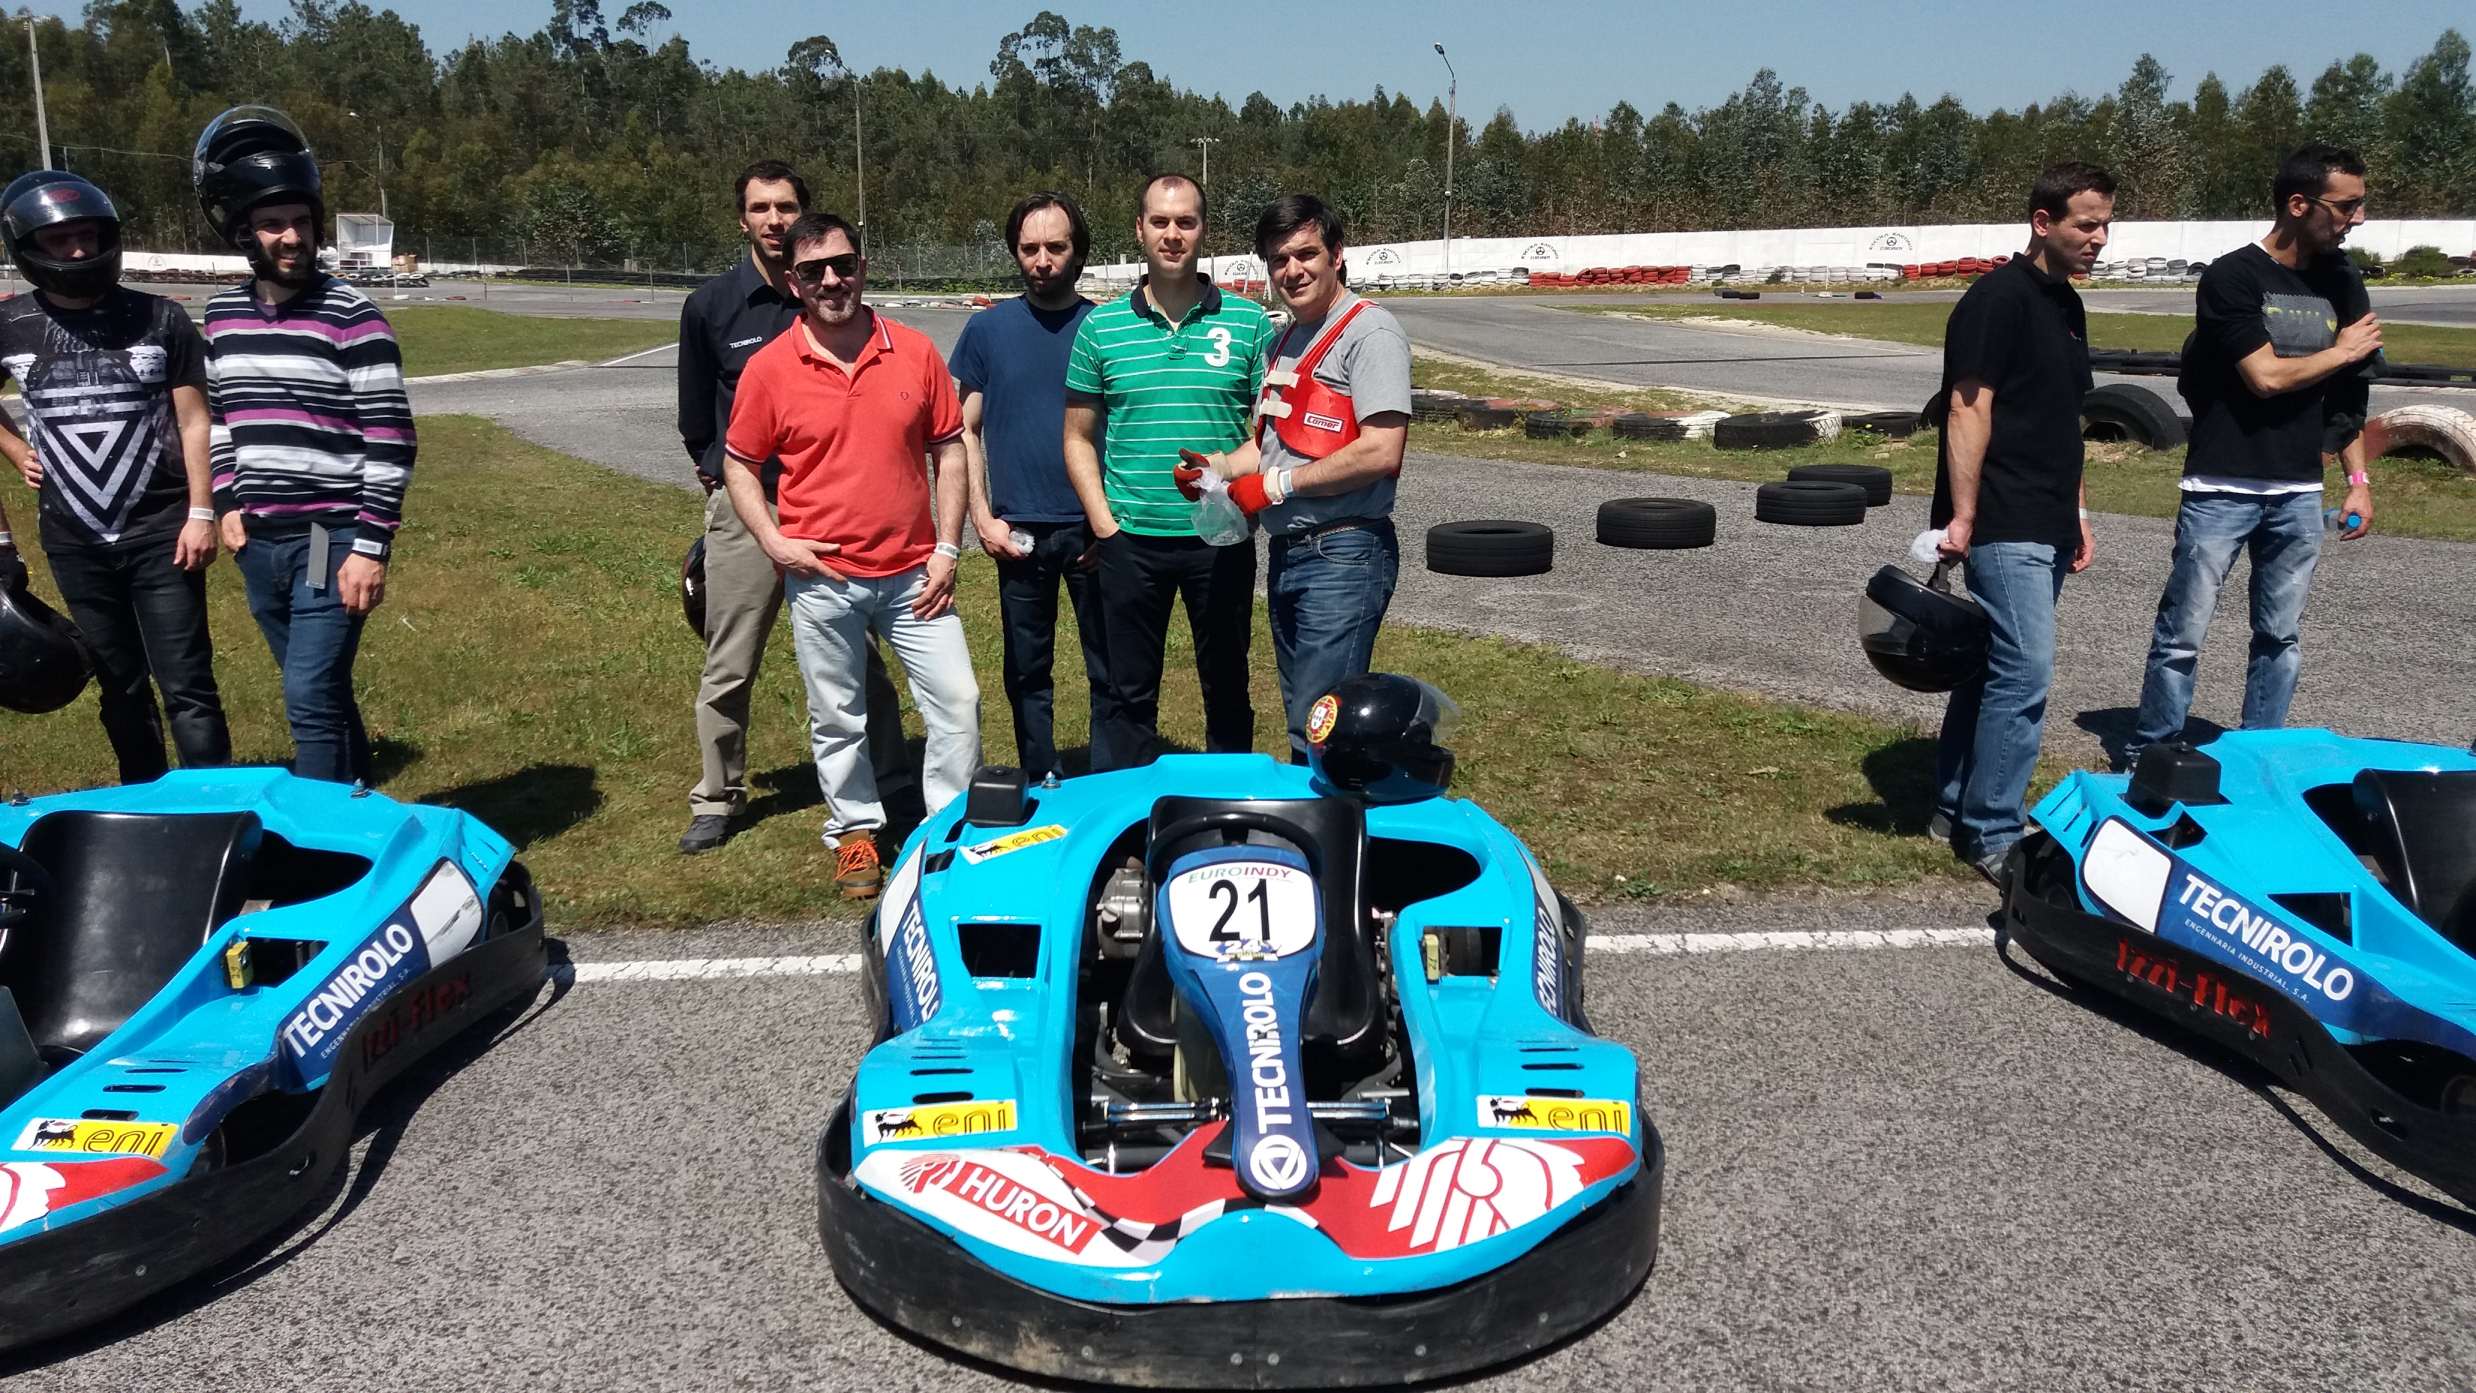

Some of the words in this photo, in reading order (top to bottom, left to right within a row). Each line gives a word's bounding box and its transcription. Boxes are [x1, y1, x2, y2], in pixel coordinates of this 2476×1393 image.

[1204, 327, 1231, 367] 3
[1188, 866, 1292, 884] EUROINDY
[1209, 878, 1271, 942] 21
[2178, 873, 2354, 1001] TECNIROLO
[2184, 918, 2236, 955] ENGENHARIA
[282, 923, 414, 1058] TECNIROLO
[1238, 971, 1292, 1135] TECNIROLO
[932, 1100, 1008, 1137] eni
[1547, 1100, 1623, 1134] eni
[83, 1123, 168, 1156] eni
[959, 1167, 1088, 1247] HURON
